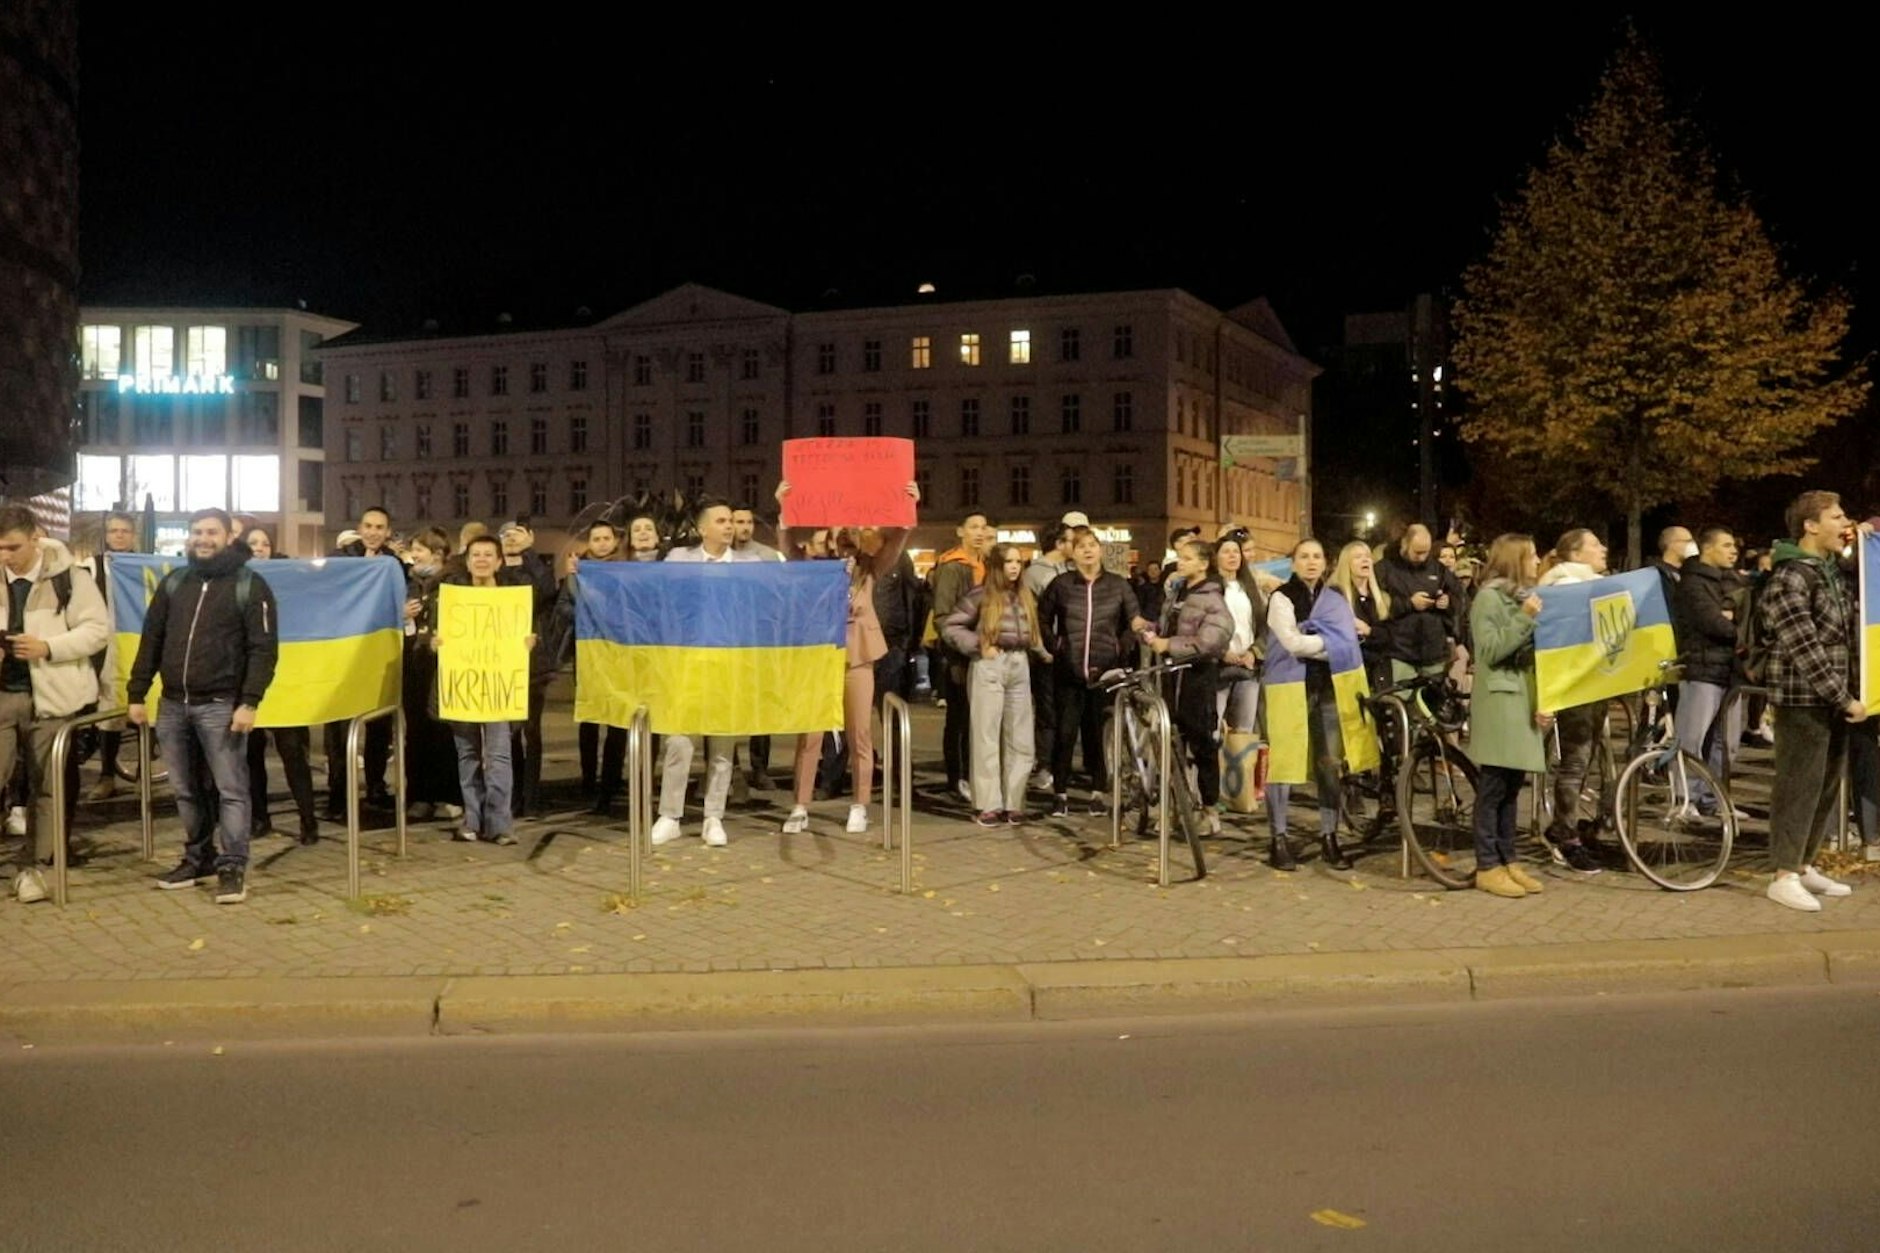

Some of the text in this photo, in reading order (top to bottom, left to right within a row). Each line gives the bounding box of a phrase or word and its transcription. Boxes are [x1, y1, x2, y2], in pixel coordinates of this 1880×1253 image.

[118, 374, 234, 394] PRIMARK
[447, 602, 529, 640] STAND
[440, 668, 526, 712] UKRAINE
